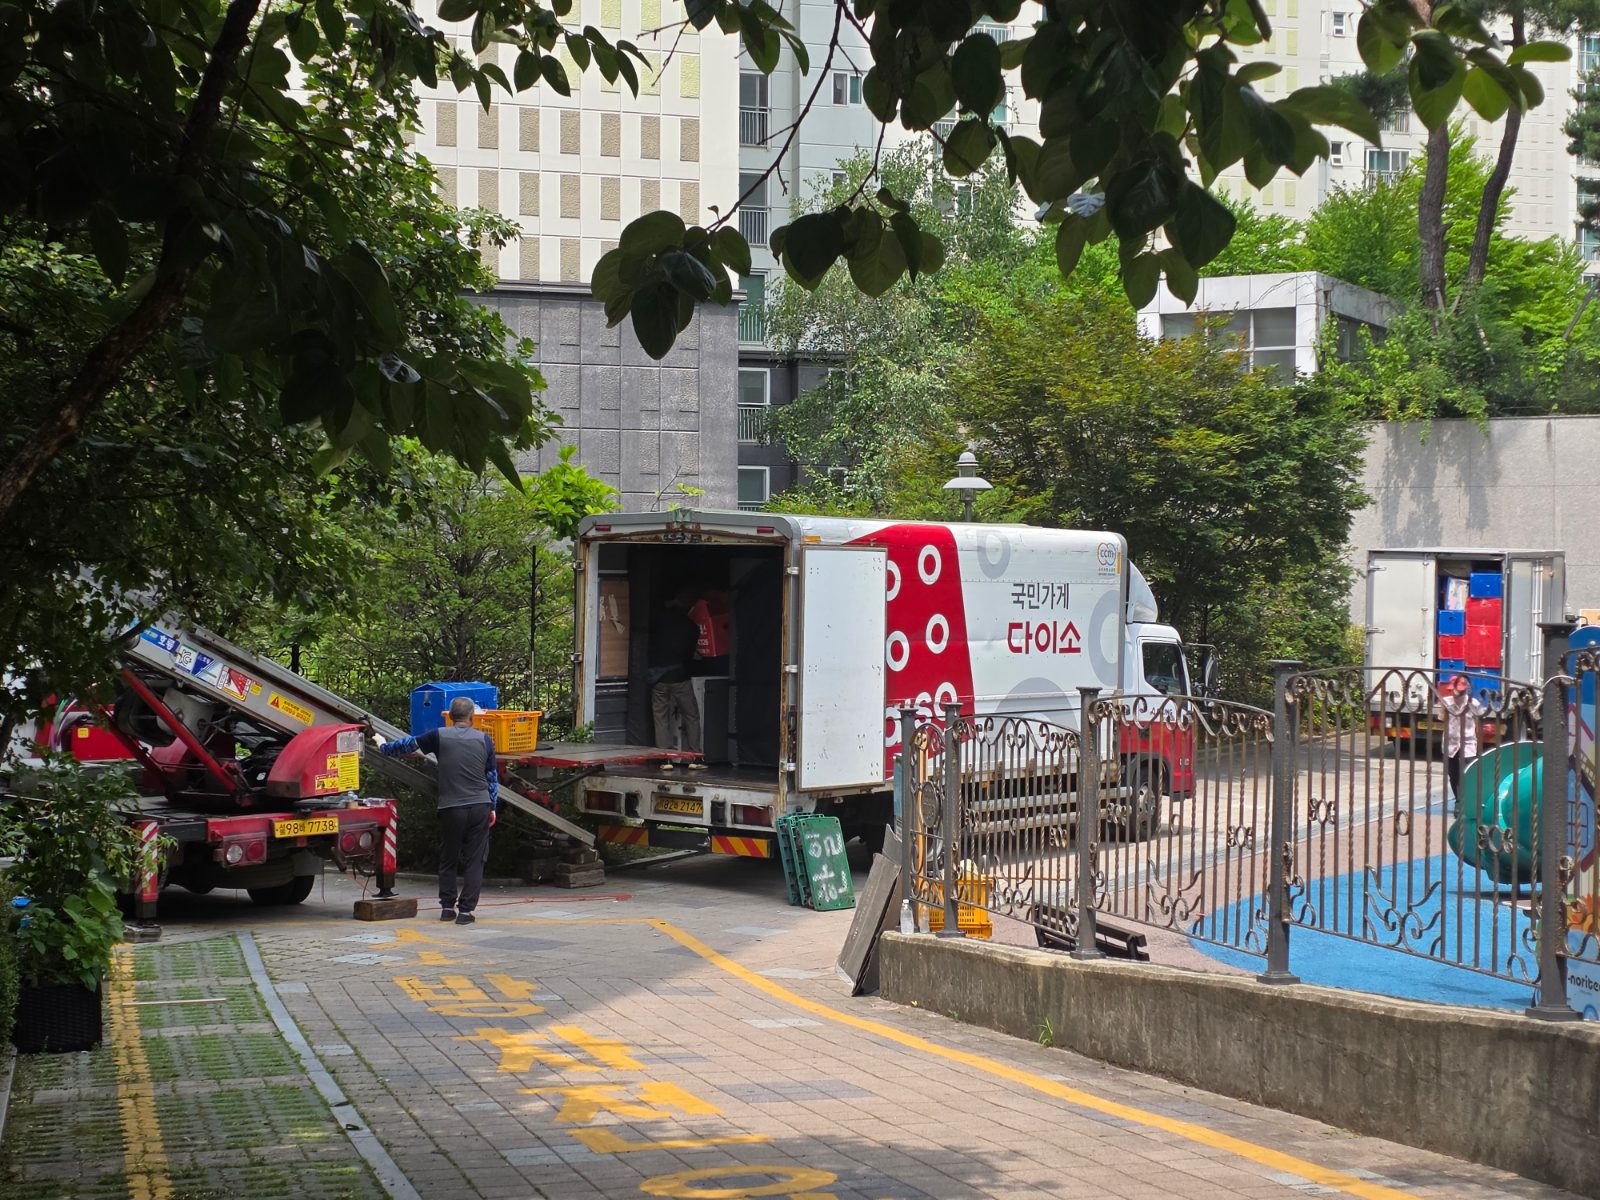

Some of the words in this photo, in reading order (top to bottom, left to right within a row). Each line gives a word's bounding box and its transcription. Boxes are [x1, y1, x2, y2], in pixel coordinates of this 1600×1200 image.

[1011, 582, 1069, 610] 국민가게
[1007, 620, 1081, 654] 다이소
[307, 820, 334, 832] 7738
